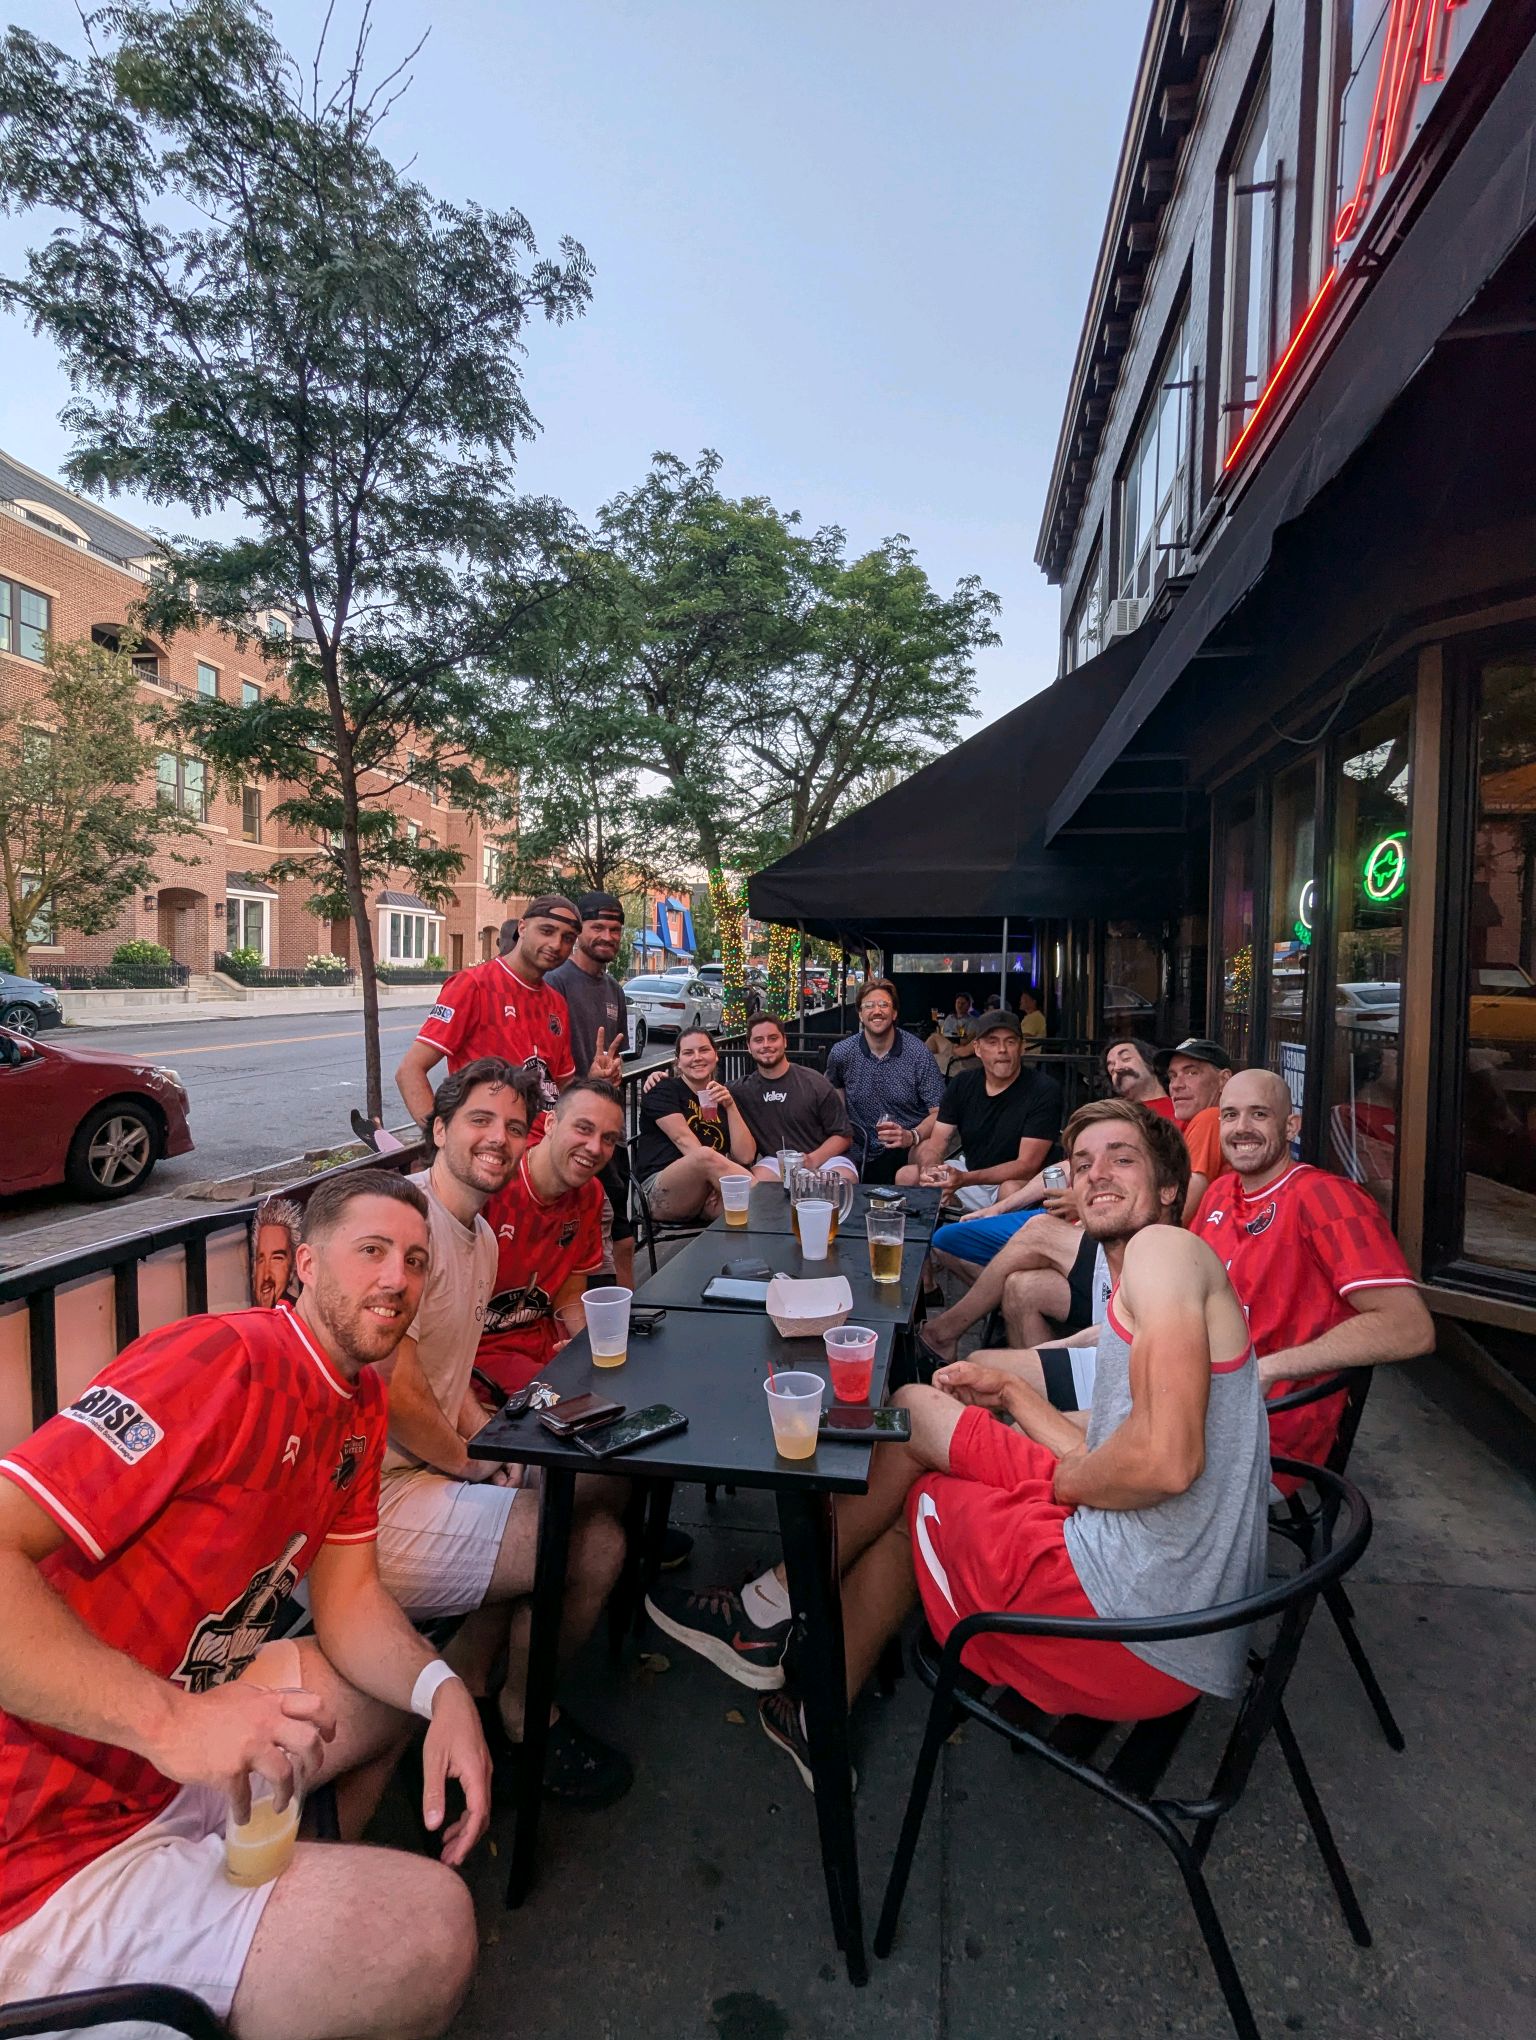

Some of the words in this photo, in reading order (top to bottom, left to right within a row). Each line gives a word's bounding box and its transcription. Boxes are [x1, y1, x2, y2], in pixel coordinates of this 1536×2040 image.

[71, 1389, 144, 1443] BDSL
[103, 1430, 119, 1446] Soccer
[118, 1444, 134, 1461] League
